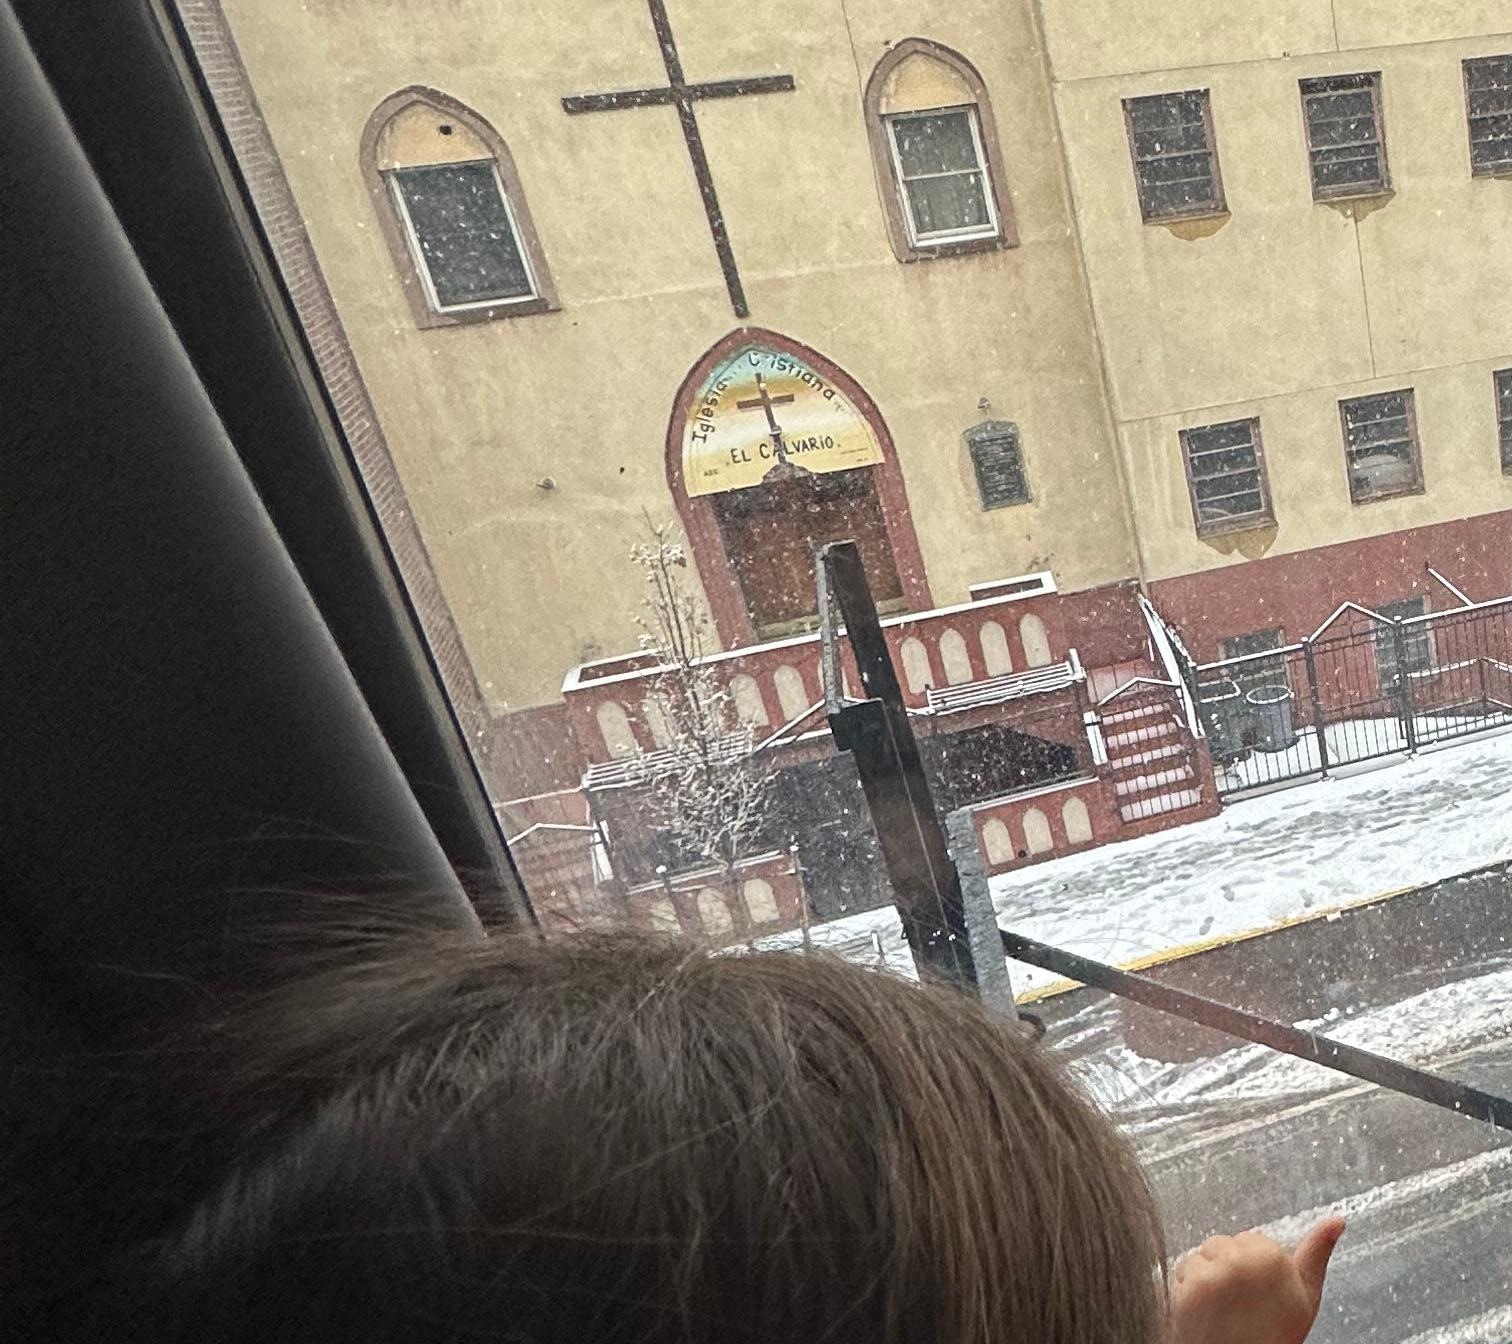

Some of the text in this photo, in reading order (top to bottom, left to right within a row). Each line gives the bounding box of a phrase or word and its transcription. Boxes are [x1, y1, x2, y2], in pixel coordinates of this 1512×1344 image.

[691, 352, 836, 444] Iglesia Cistiana
[730, 448, 752, 464] EL
